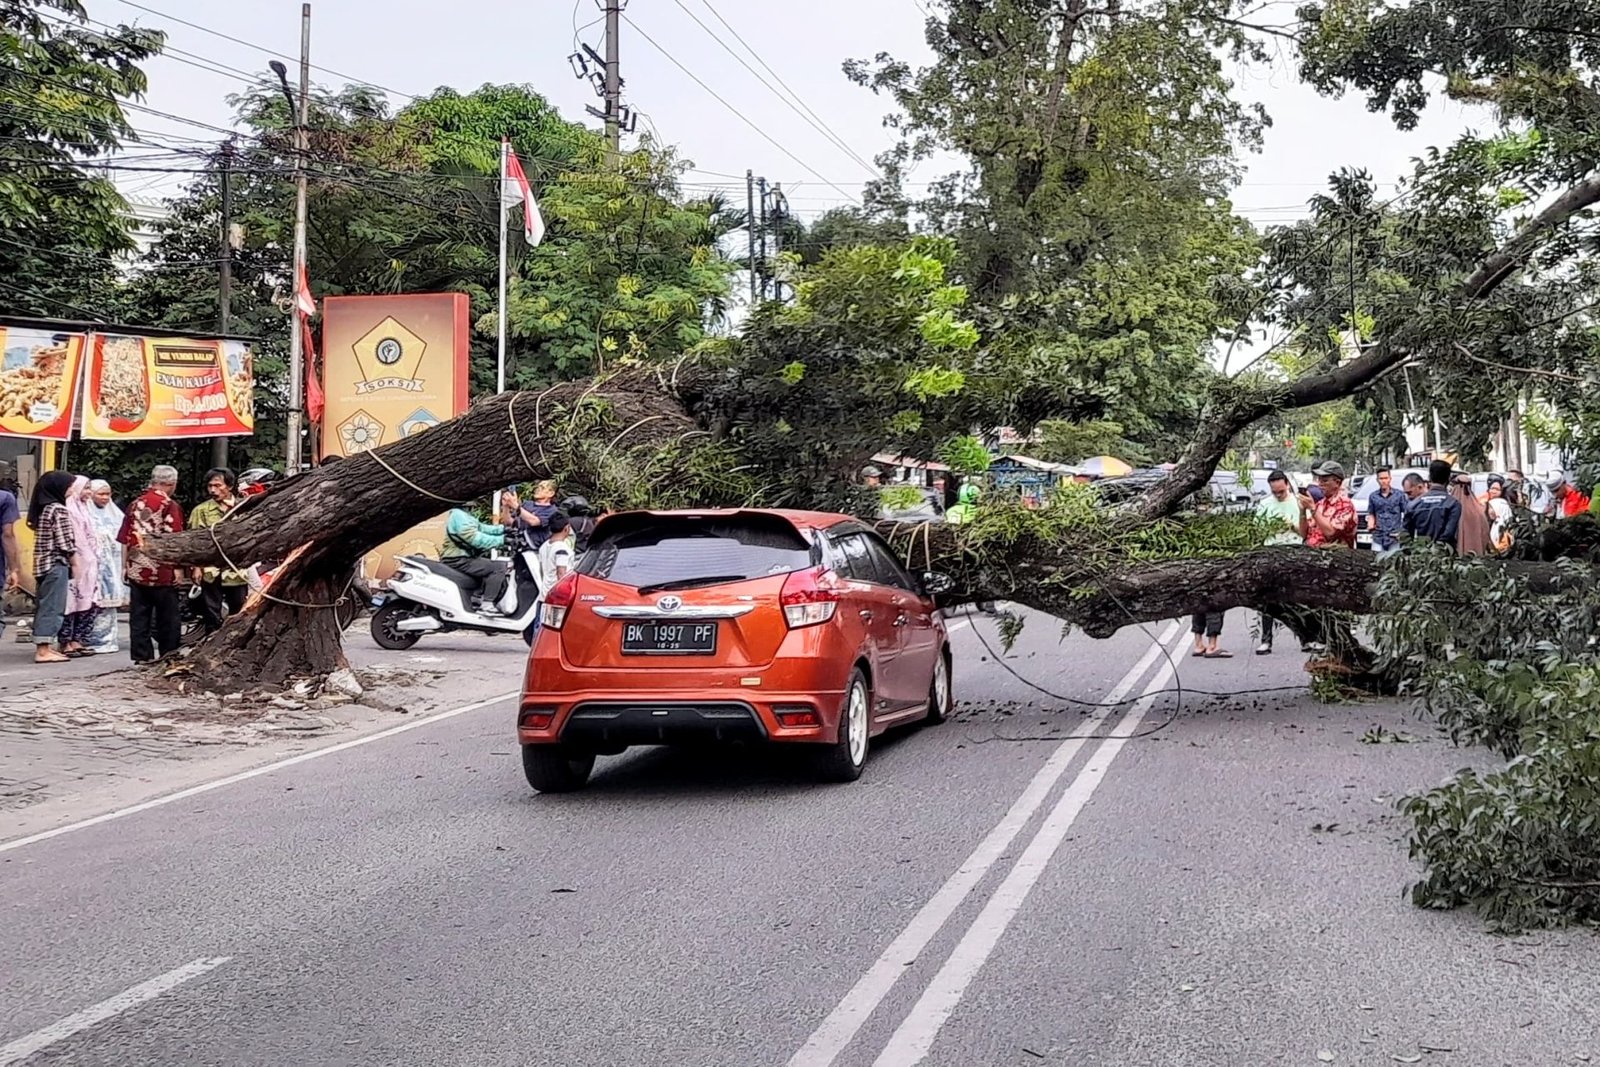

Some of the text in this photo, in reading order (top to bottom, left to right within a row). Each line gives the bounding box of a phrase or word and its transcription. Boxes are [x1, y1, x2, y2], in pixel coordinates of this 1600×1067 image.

[156, 371, 184, 389] ENAK
[368, 379, 410, 391] SOKSI
[627, 625, 712, 642] BK 1997 PF
